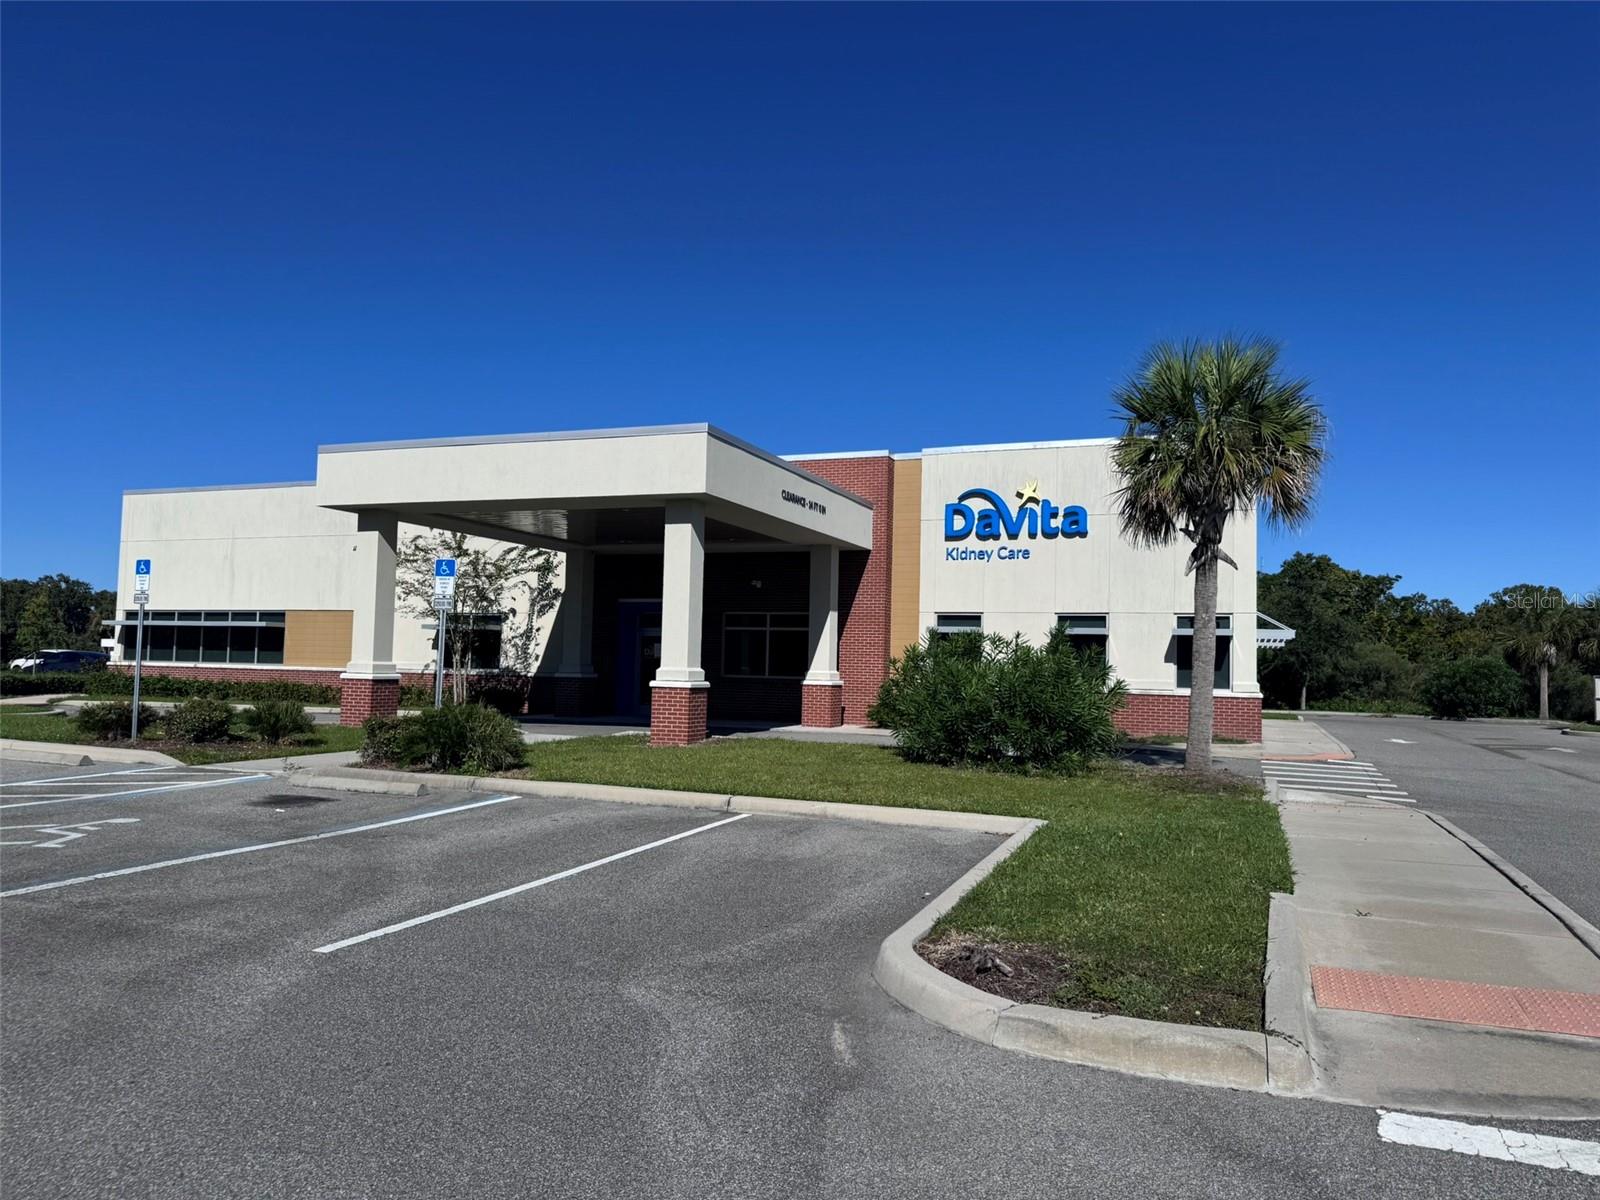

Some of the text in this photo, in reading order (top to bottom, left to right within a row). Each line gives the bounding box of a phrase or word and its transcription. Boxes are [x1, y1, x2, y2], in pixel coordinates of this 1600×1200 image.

[781, 489, 806, 508] CLEARANCE
[944, 488, 1088, 541] DaVita
[945, 546, 1031, 562] Kidney Care
